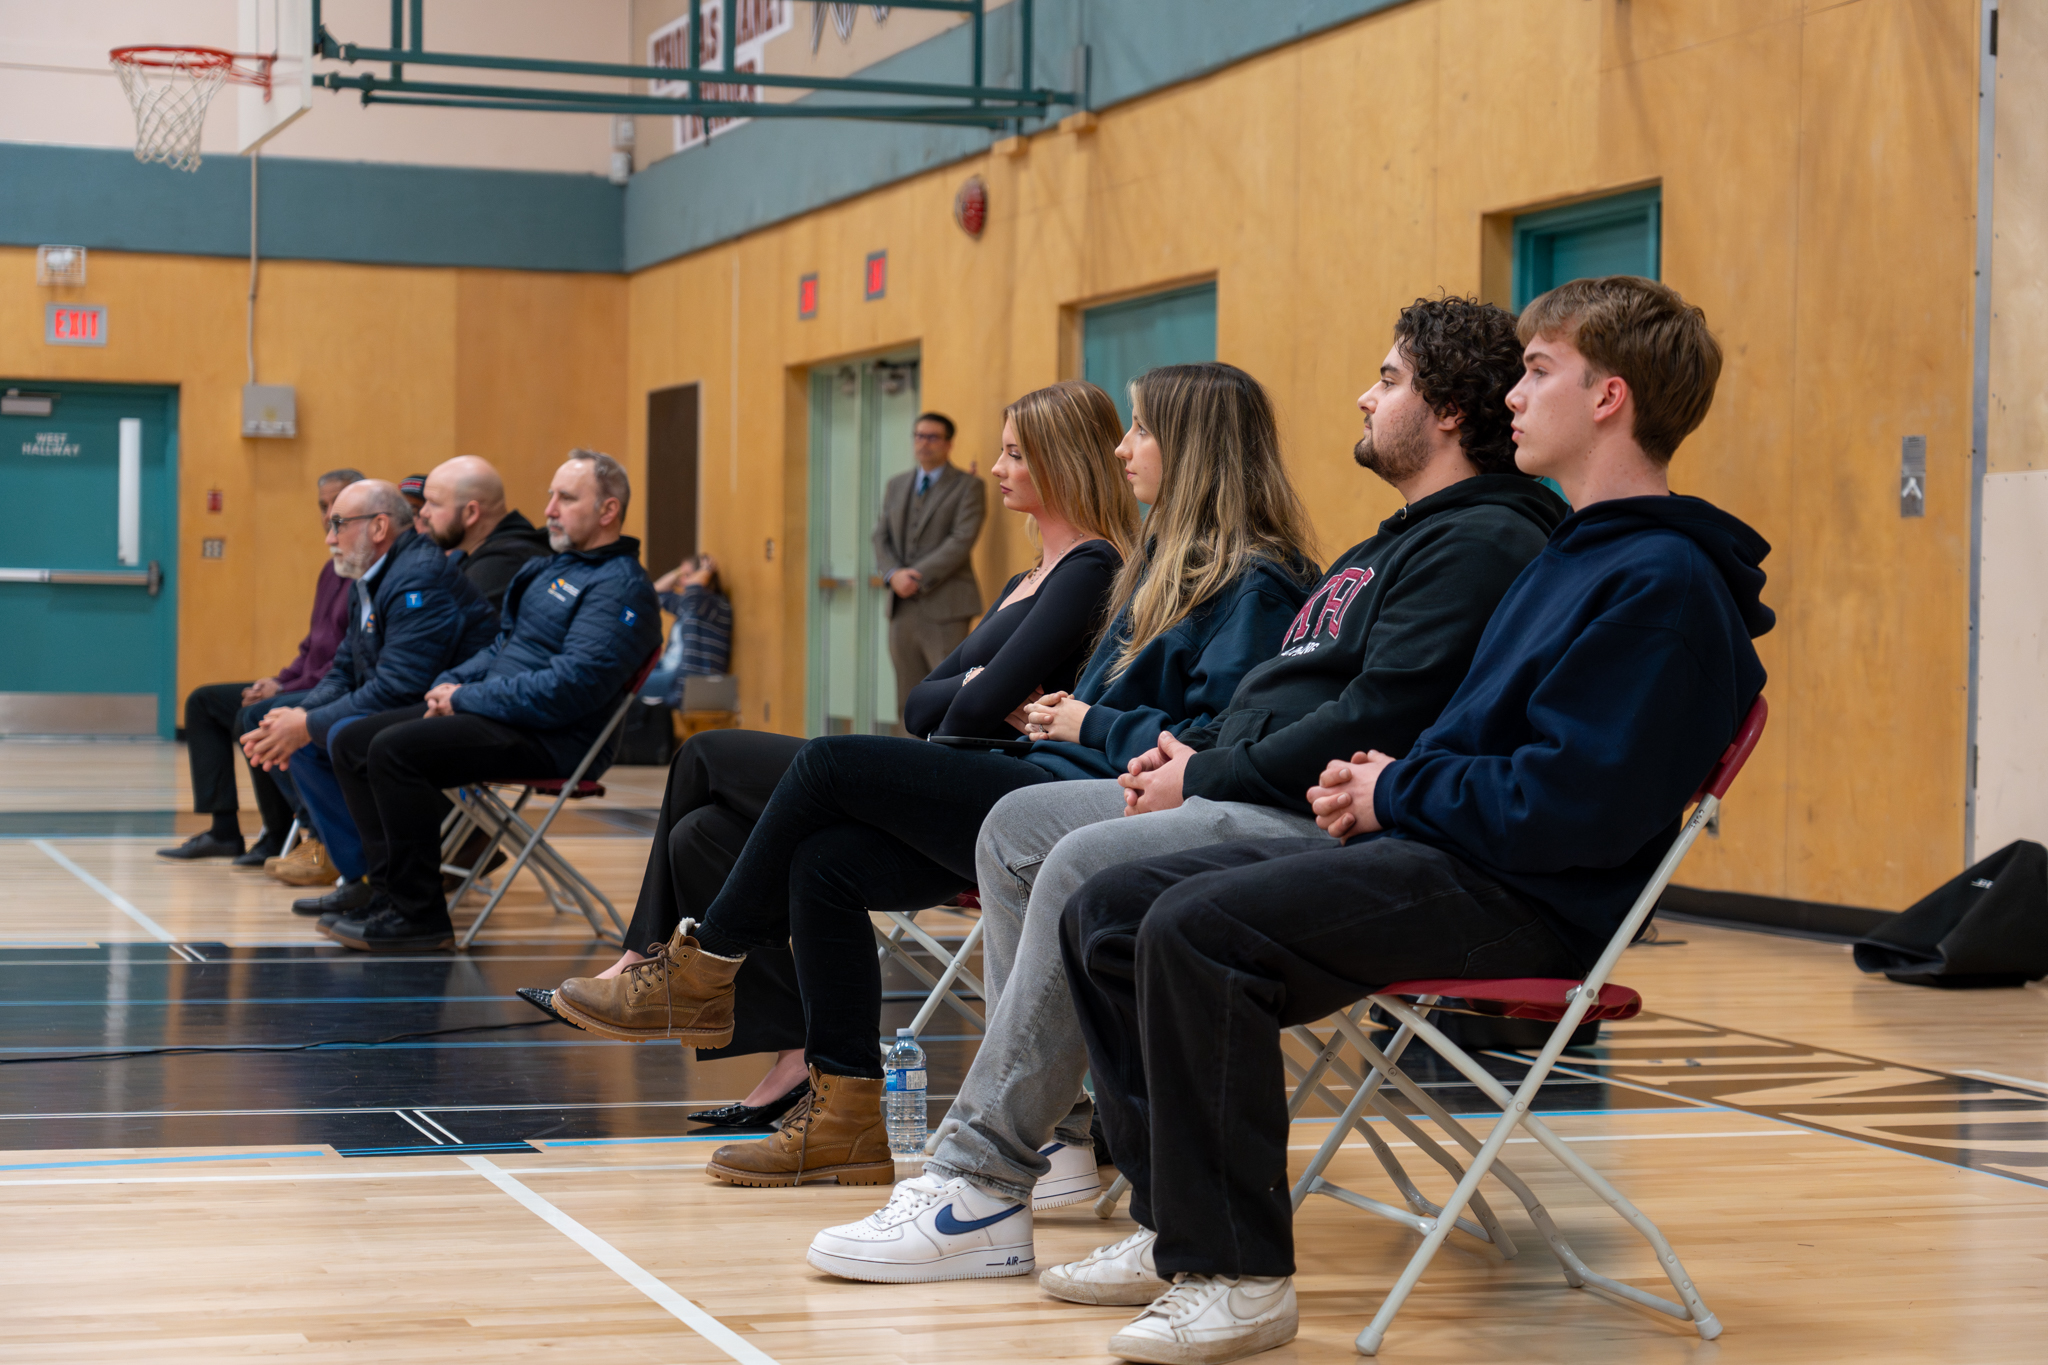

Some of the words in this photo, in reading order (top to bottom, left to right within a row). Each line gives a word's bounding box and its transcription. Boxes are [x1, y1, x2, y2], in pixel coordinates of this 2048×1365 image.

[55, 309, 99, 340] EXIT
[36, 432, 67, 444] WEST
[22, 442, 80, 457] HALLWAY
[1005, 1256, 1019, 1266] AIR
